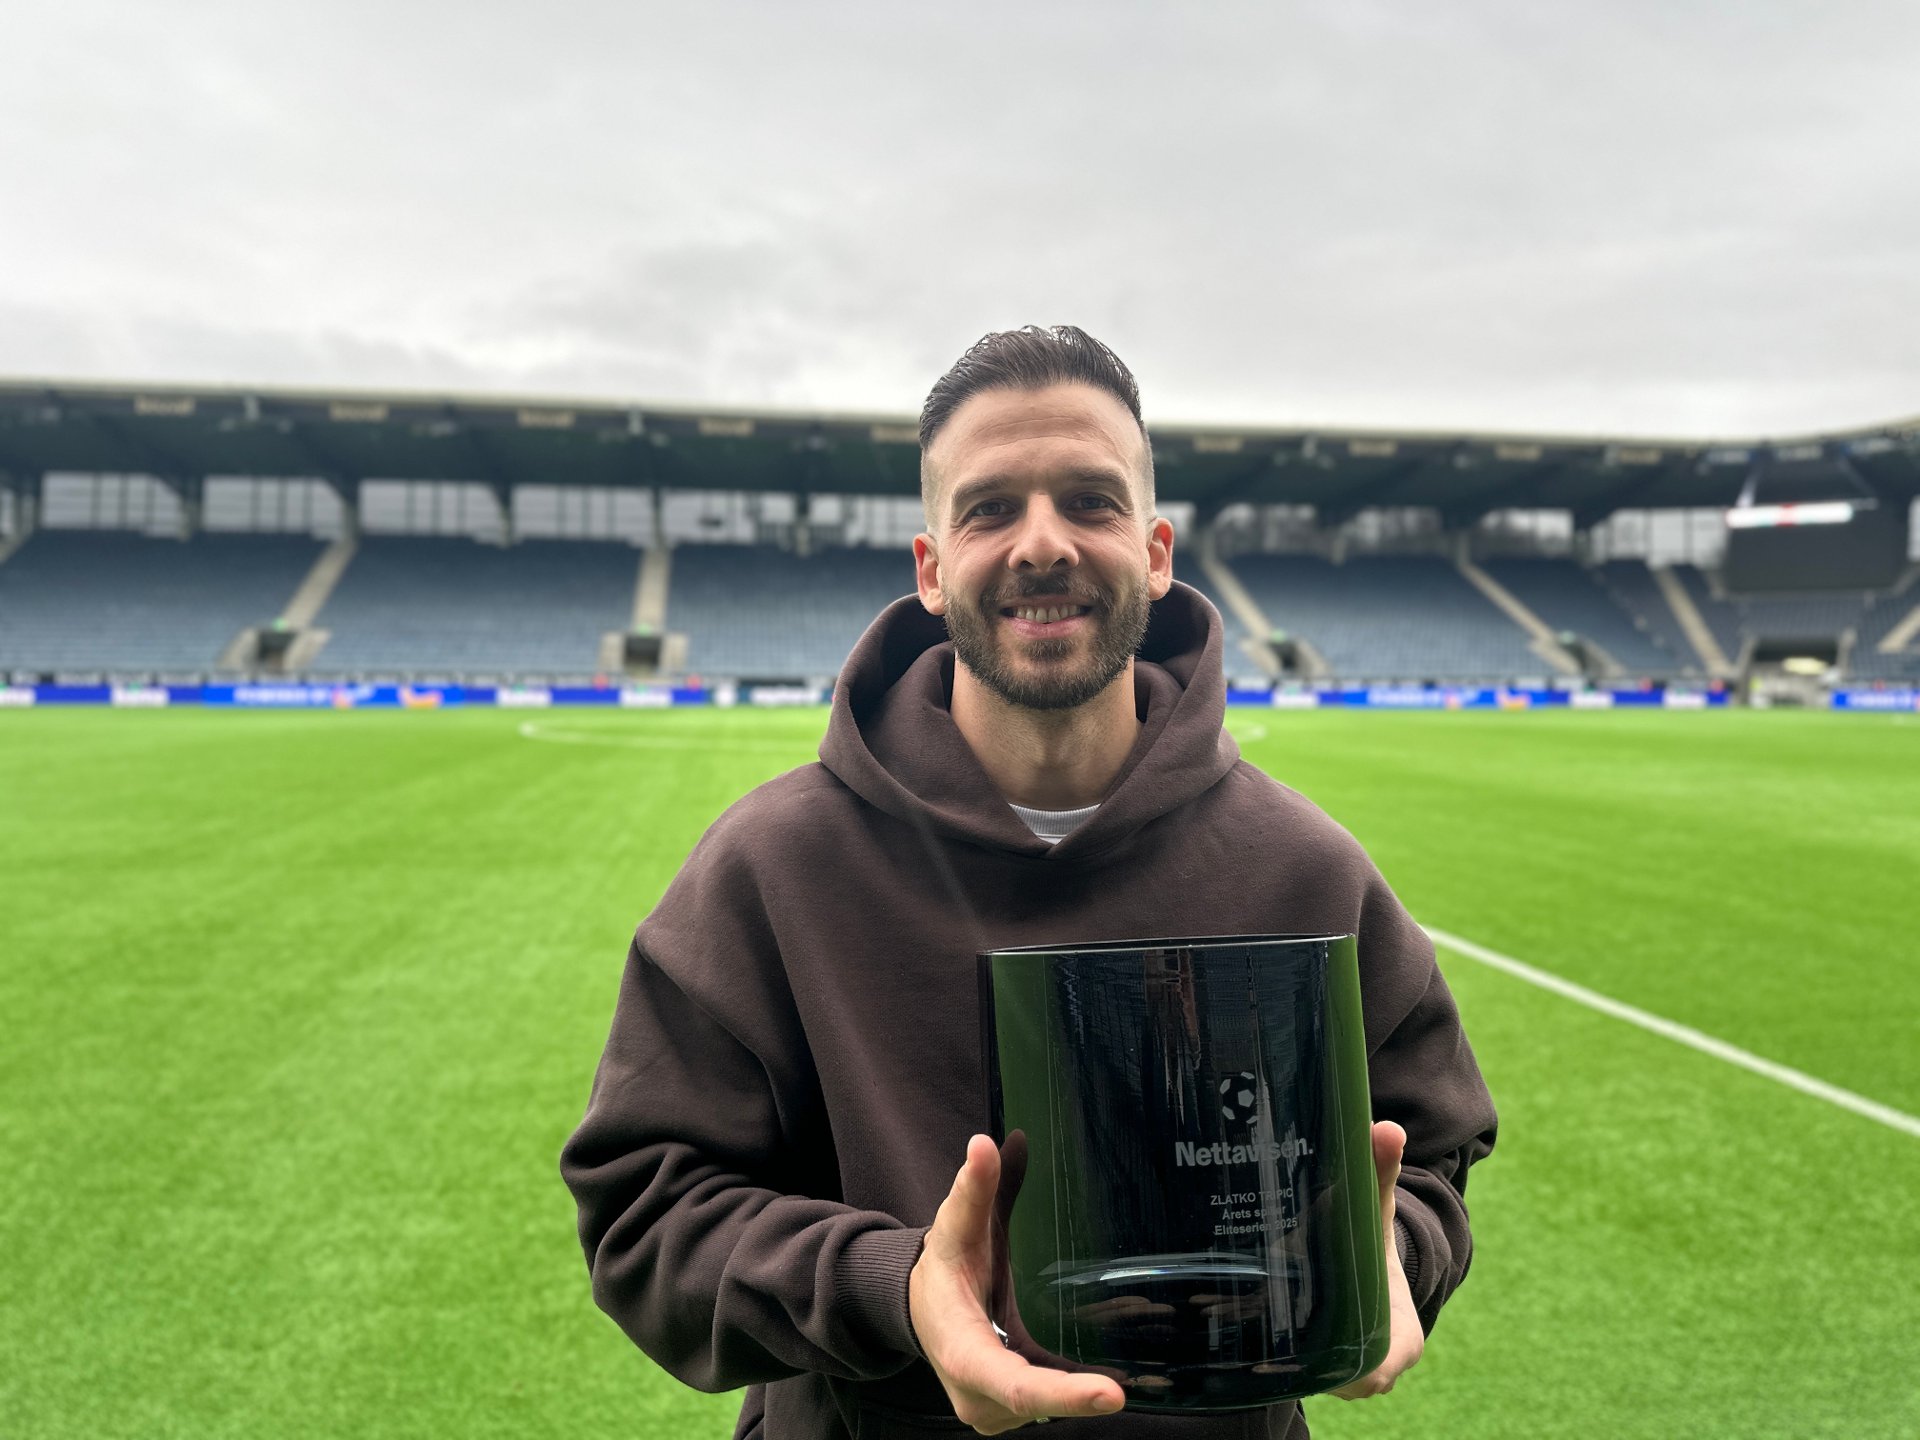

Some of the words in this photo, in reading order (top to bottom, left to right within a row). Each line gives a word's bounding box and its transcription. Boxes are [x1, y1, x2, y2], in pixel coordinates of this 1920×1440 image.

[1210, 1192, 1256, 1206] ZLATKO
[1254, 1205, 1286, 1219] sper
[1214, 1221, 1272, 1236] Eliteserien
[1274, 1216, 1297, 1231] 2025
